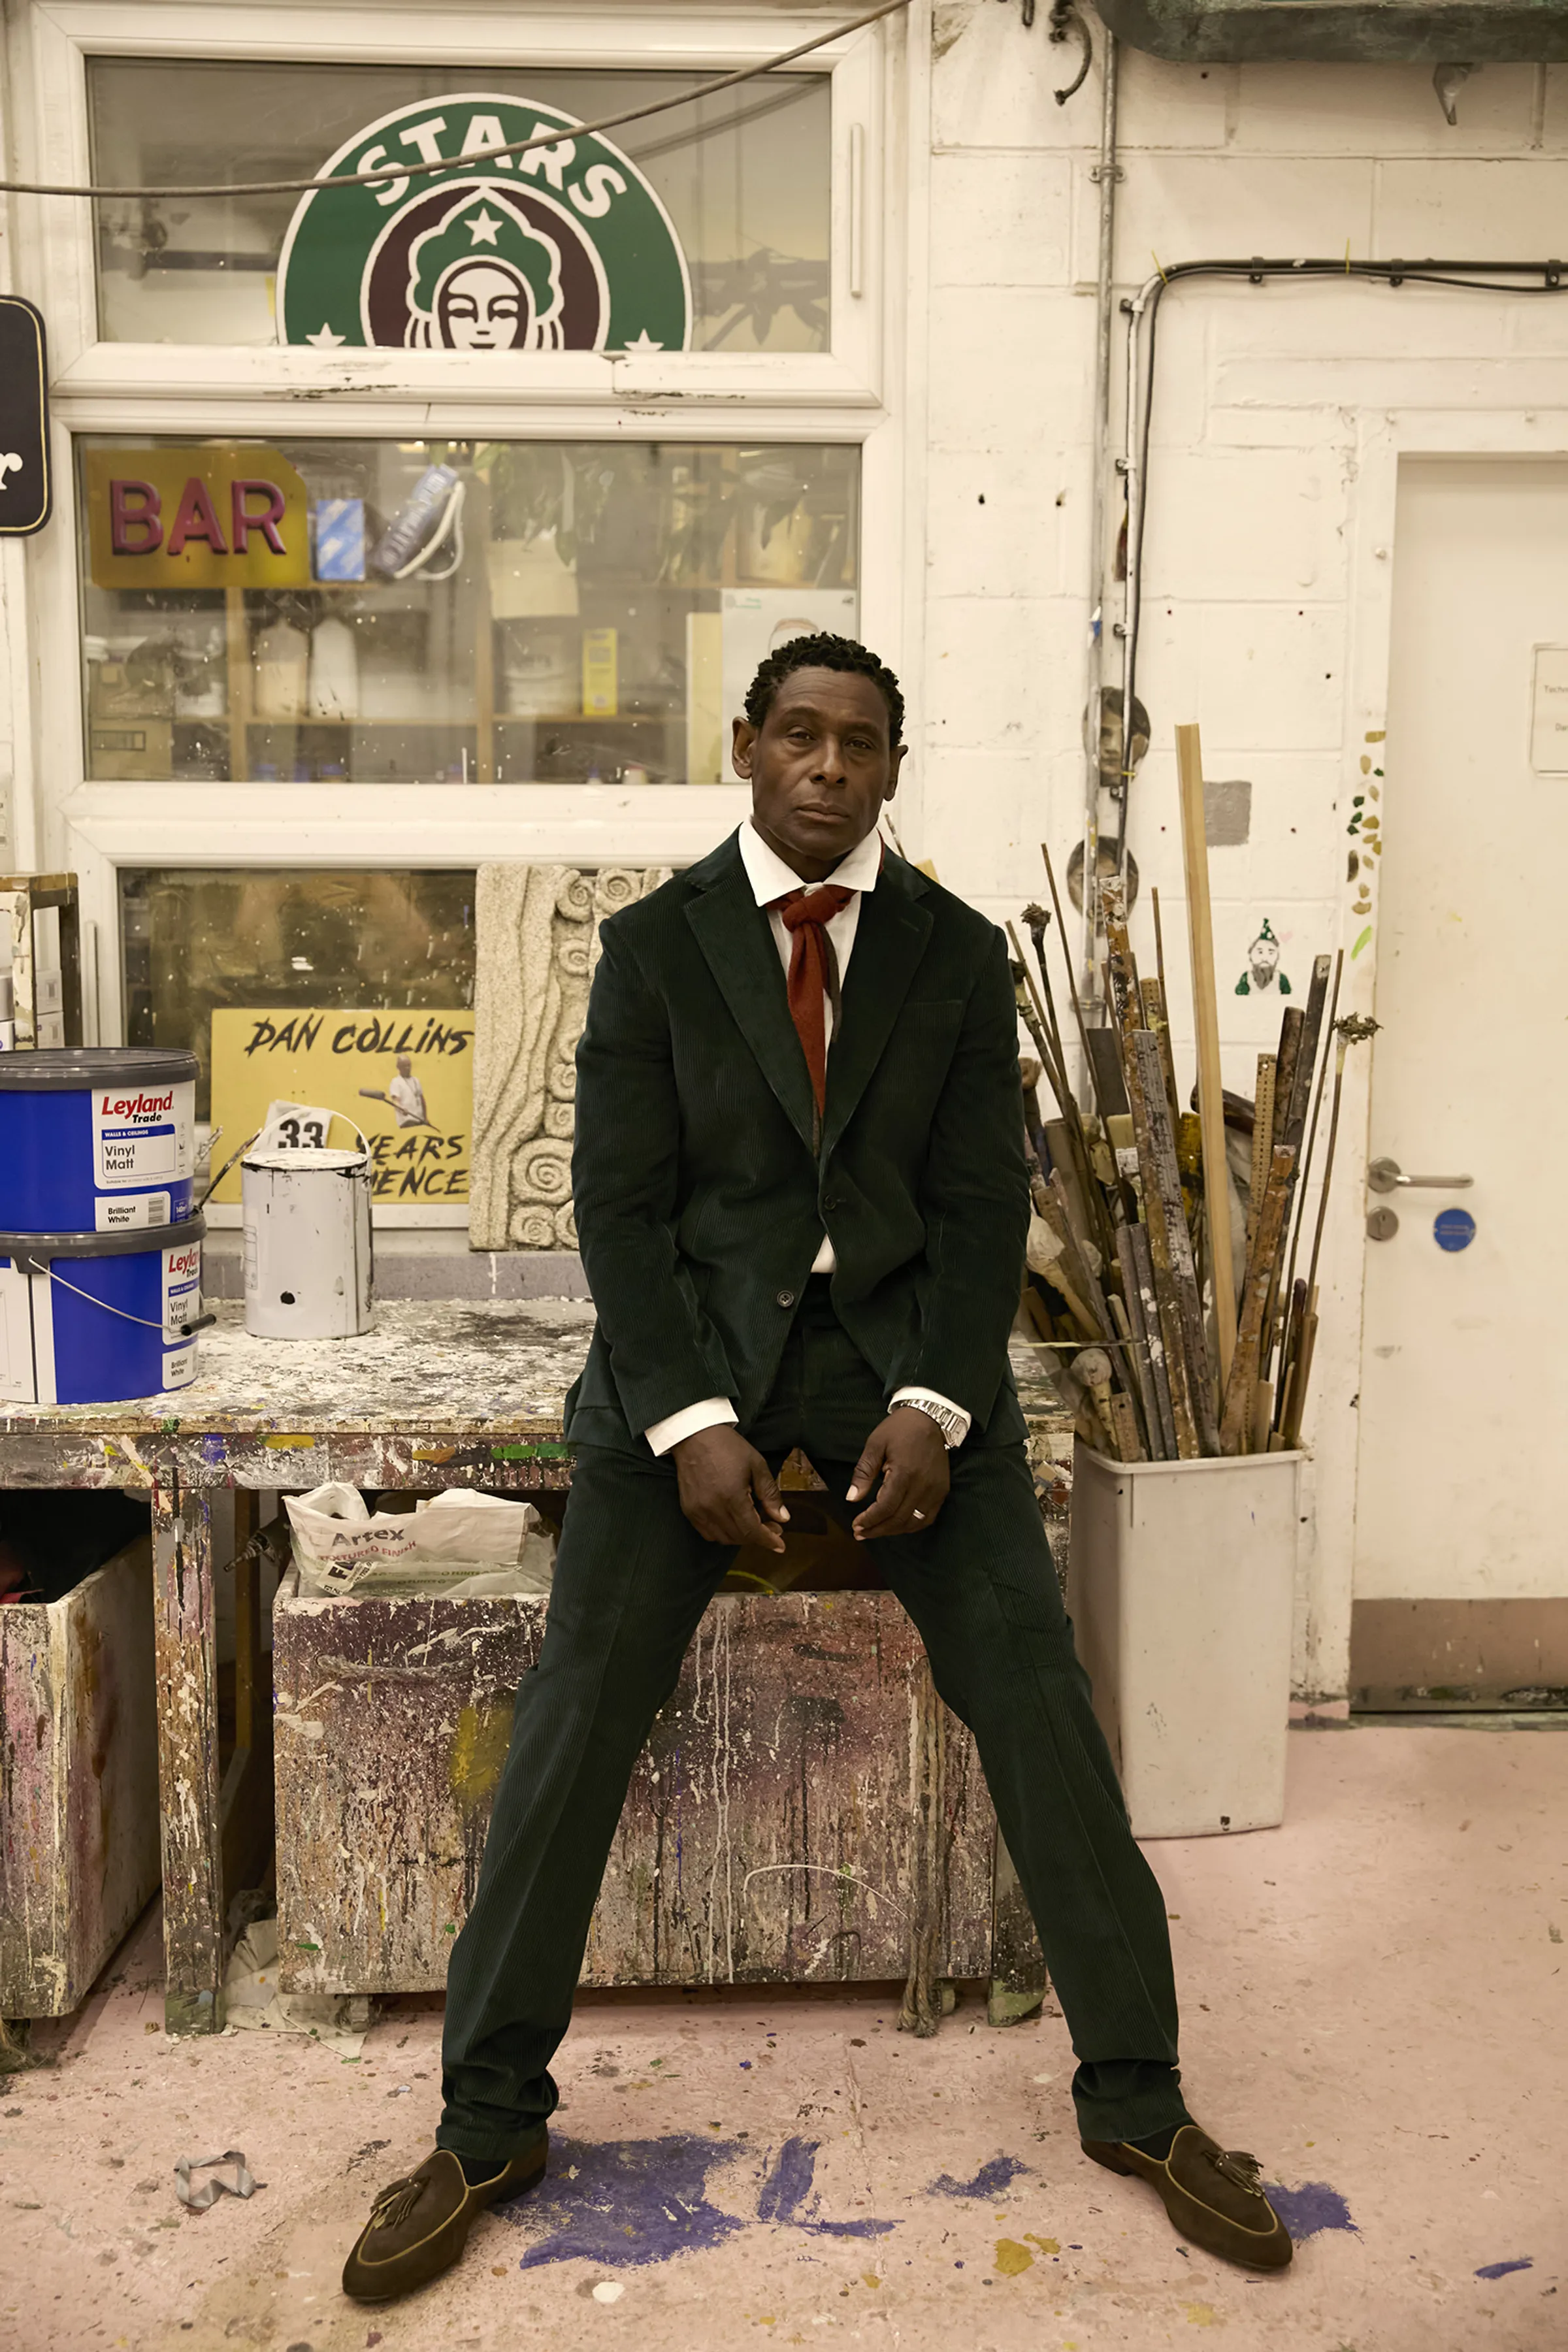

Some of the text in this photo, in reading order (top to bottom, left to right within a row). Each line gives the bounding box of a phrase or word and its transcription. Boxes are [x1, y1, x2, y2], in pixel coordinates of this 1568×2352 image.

[357, 115, 627, 218] STARS
[110, 478, 287, 556] BAR
[244, 1013, 324, 1057] DAN
[101, 1090, 173, 1119] Leyland
[132, 1113, 162, 1123] Trade
[278, 1118, 465, 1167] 33 YEARS
[105, 1145, 135, 1157] Vinyl
[106, 1158, 134, 1170] Matt
[372, 1166, 469, 1197] IENCE
[108, 1206, 136, 1215] Brilliant
[170, 1299, 188, 1313] Vinyl
[171, 1313, 188, 1326] Matt
[171, 1358, 188, 1369] Brilliant
[171, 1368, 184, 1377] White
[332, 1529, 404, 1546] Artex
[382, 1541, 416, 1558] FINISH
